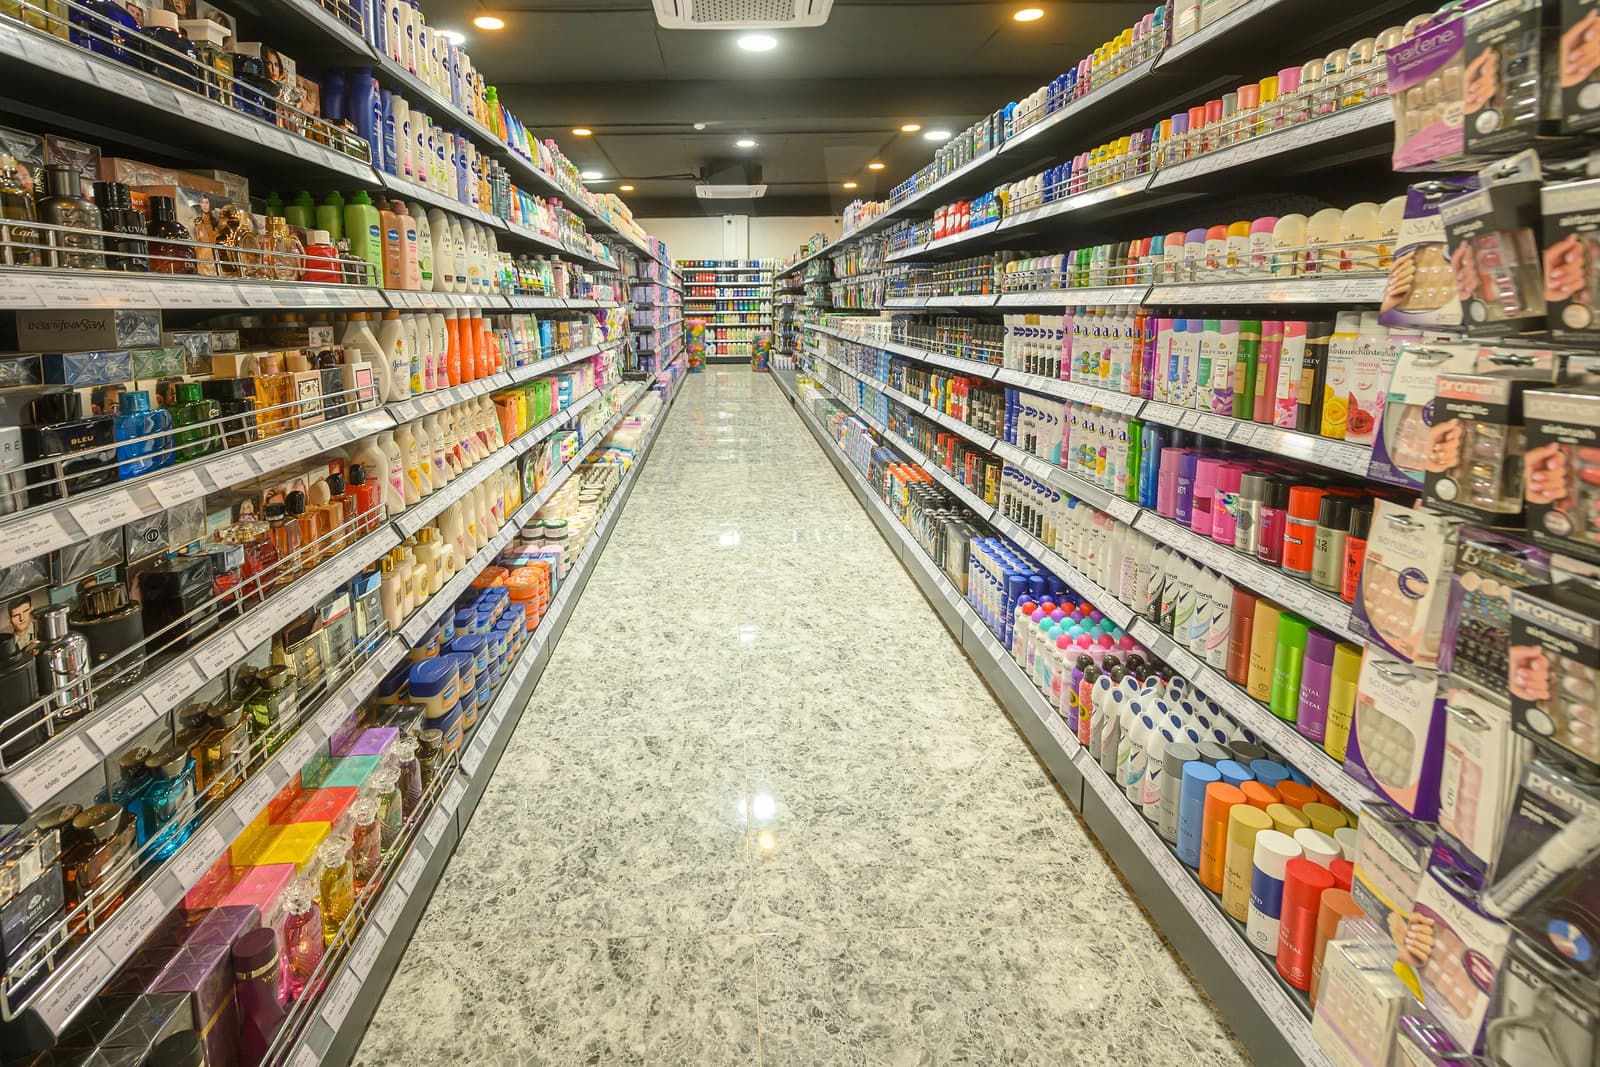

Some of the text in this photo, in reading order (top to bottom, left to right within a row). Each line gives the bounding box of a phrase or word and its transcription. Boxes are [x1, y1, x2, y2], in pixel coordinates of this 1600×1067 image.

[71, 435, 94, 445] BLEU
[60, 764, 78, 778] Dinar
[64, 975, 99, 1013] 13000 Dinar
